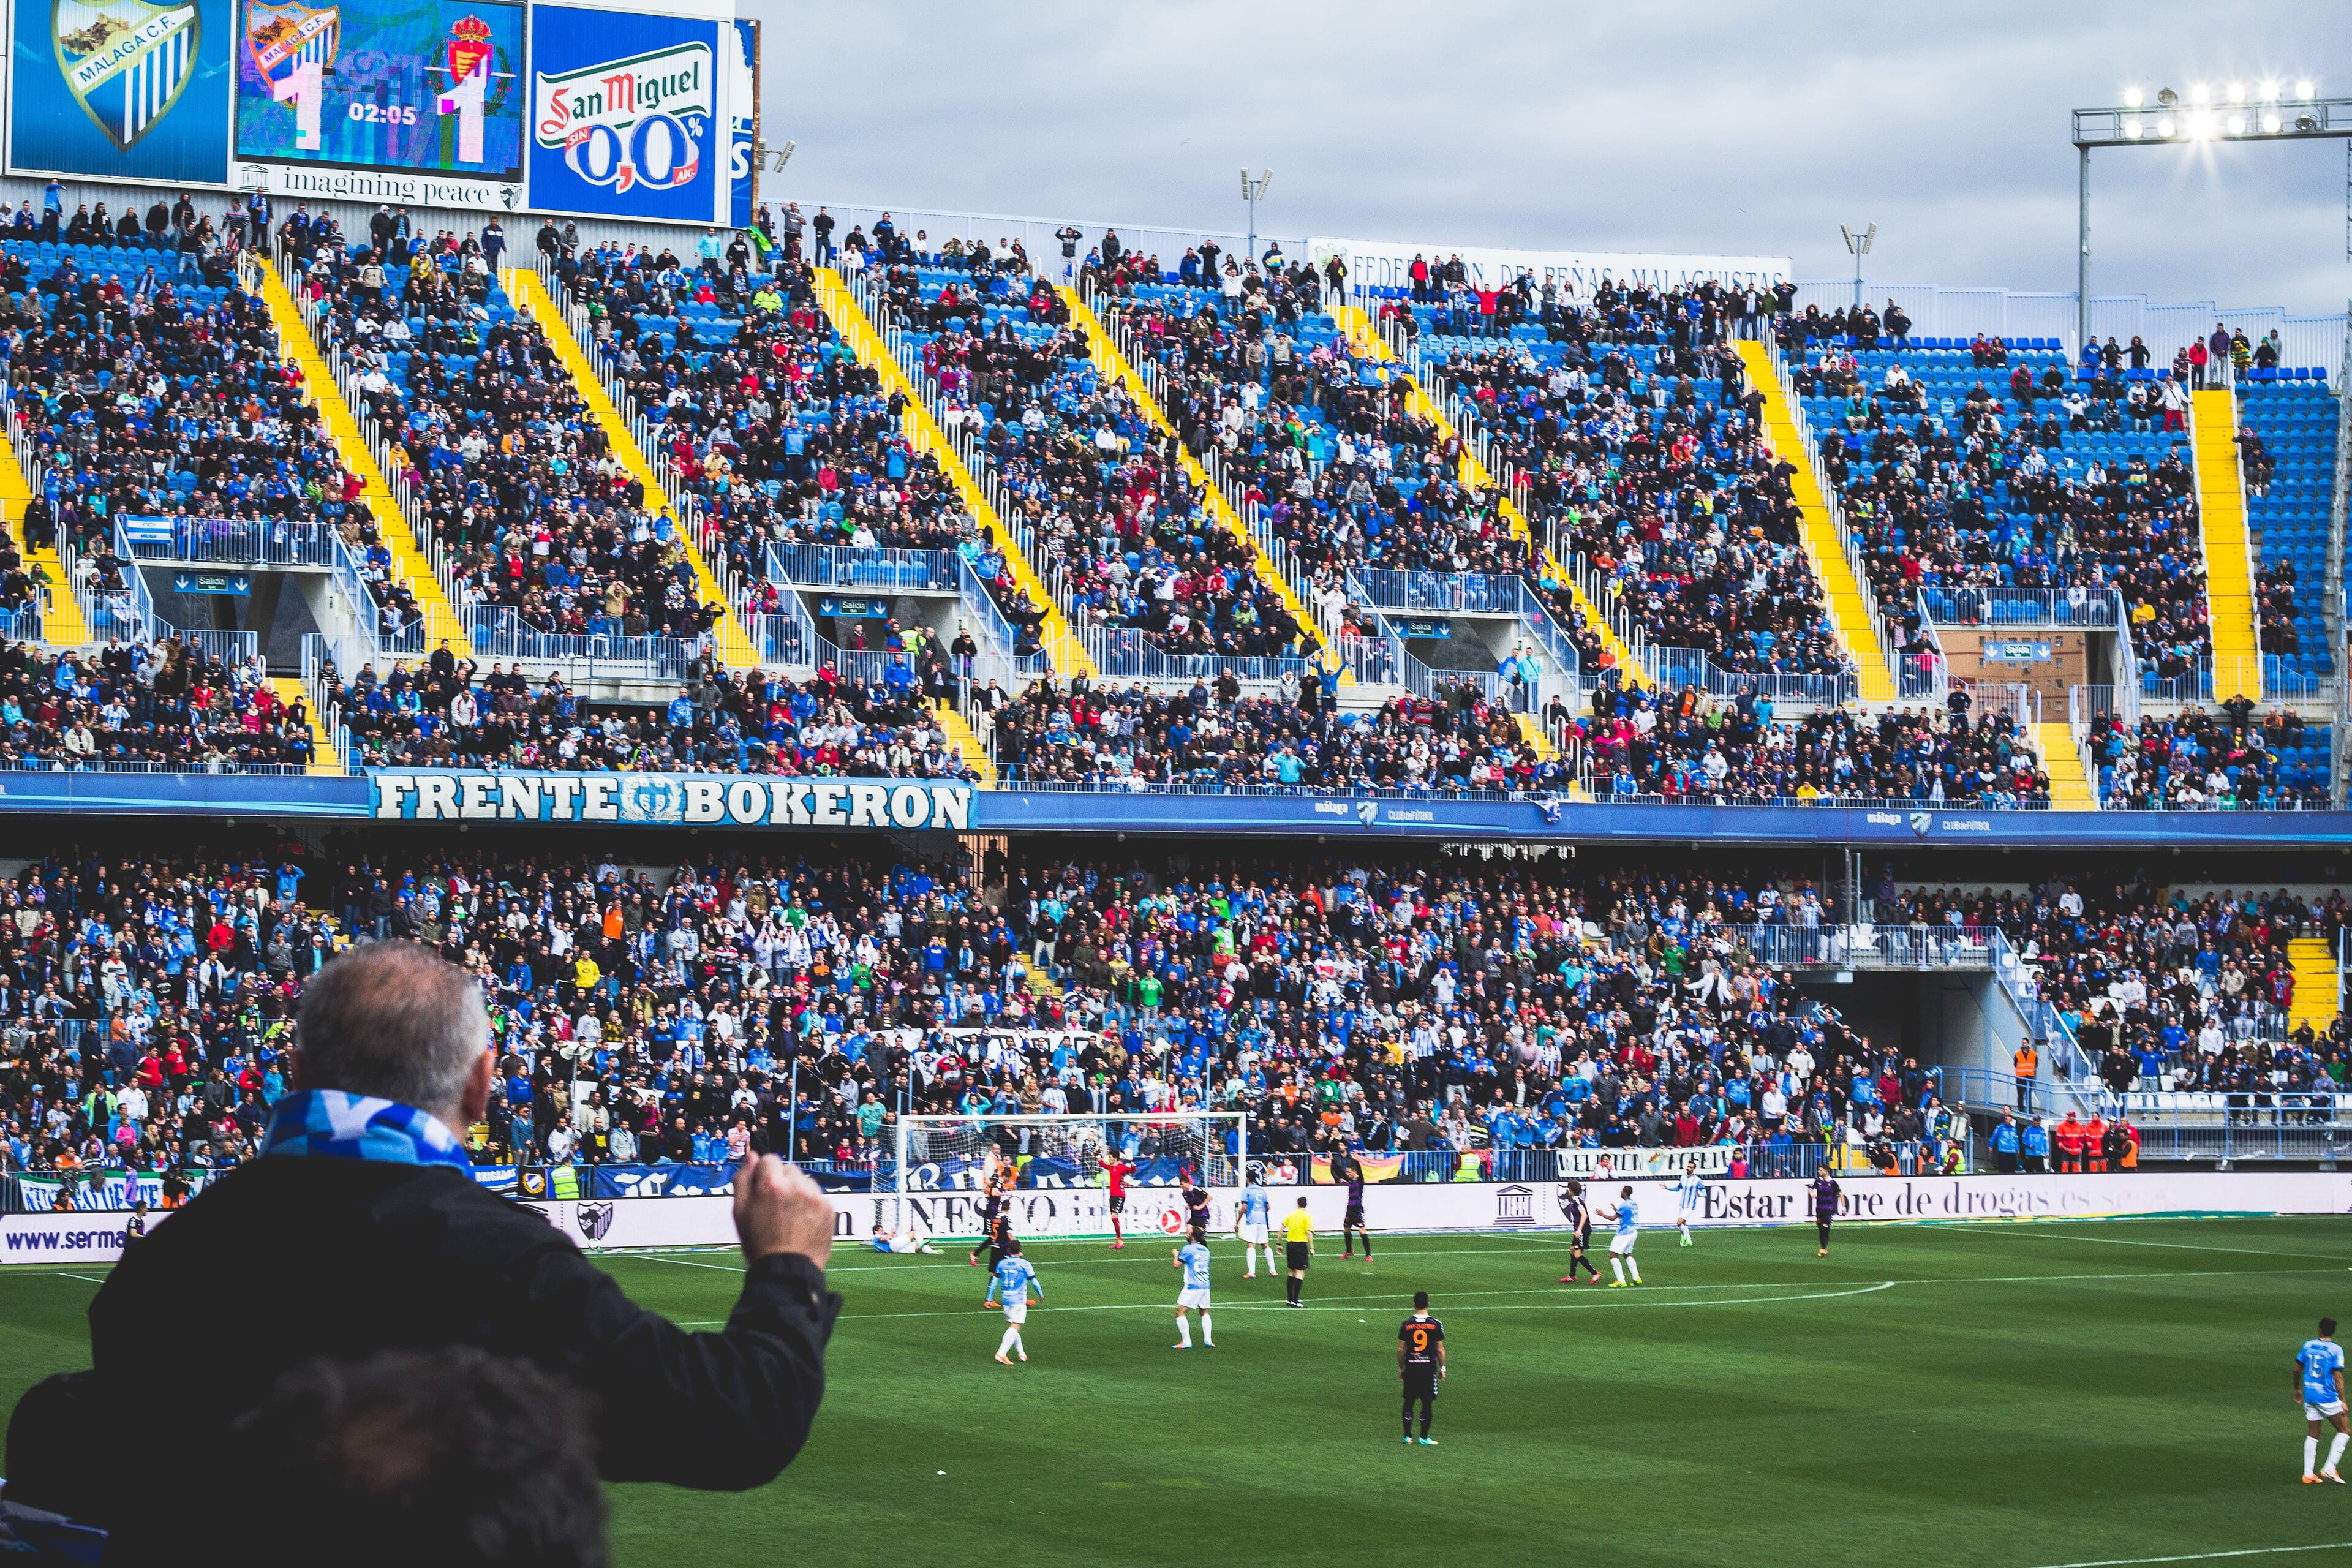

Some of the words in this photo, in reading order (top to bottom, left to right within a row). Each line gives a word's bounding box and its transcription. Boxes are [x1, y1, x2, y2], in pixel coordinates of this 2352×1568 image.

[78, 34, 146, 82] MALAGA
[146, 15, 175, 38] C.F.
[273, 62, 322, 150] 1
[541, 87, 602, 135] San
[600, 61, 698, 113] Miguel
[349, 102, 417, 126] 02:05
[568, 129, 588, 146] SIN
[285, 167, 416, 203] imagining
[424, 178, 490, 204] peace
[198, 576, 225, 586] Salida
[842, 601, 866, 609] Salida
[1411, 622, 1432, 631] Salida
[375, 775, 618, 821] FRENTE
[683, 778, 973, 831] BOKERON
[1701, 1185, 1793, 1219] Estar
[1895, 1182, 1931, 1215] de
[1943, 1182, 2049, 1217] drogas
[1412, 1329, 1428, 1352] 9
